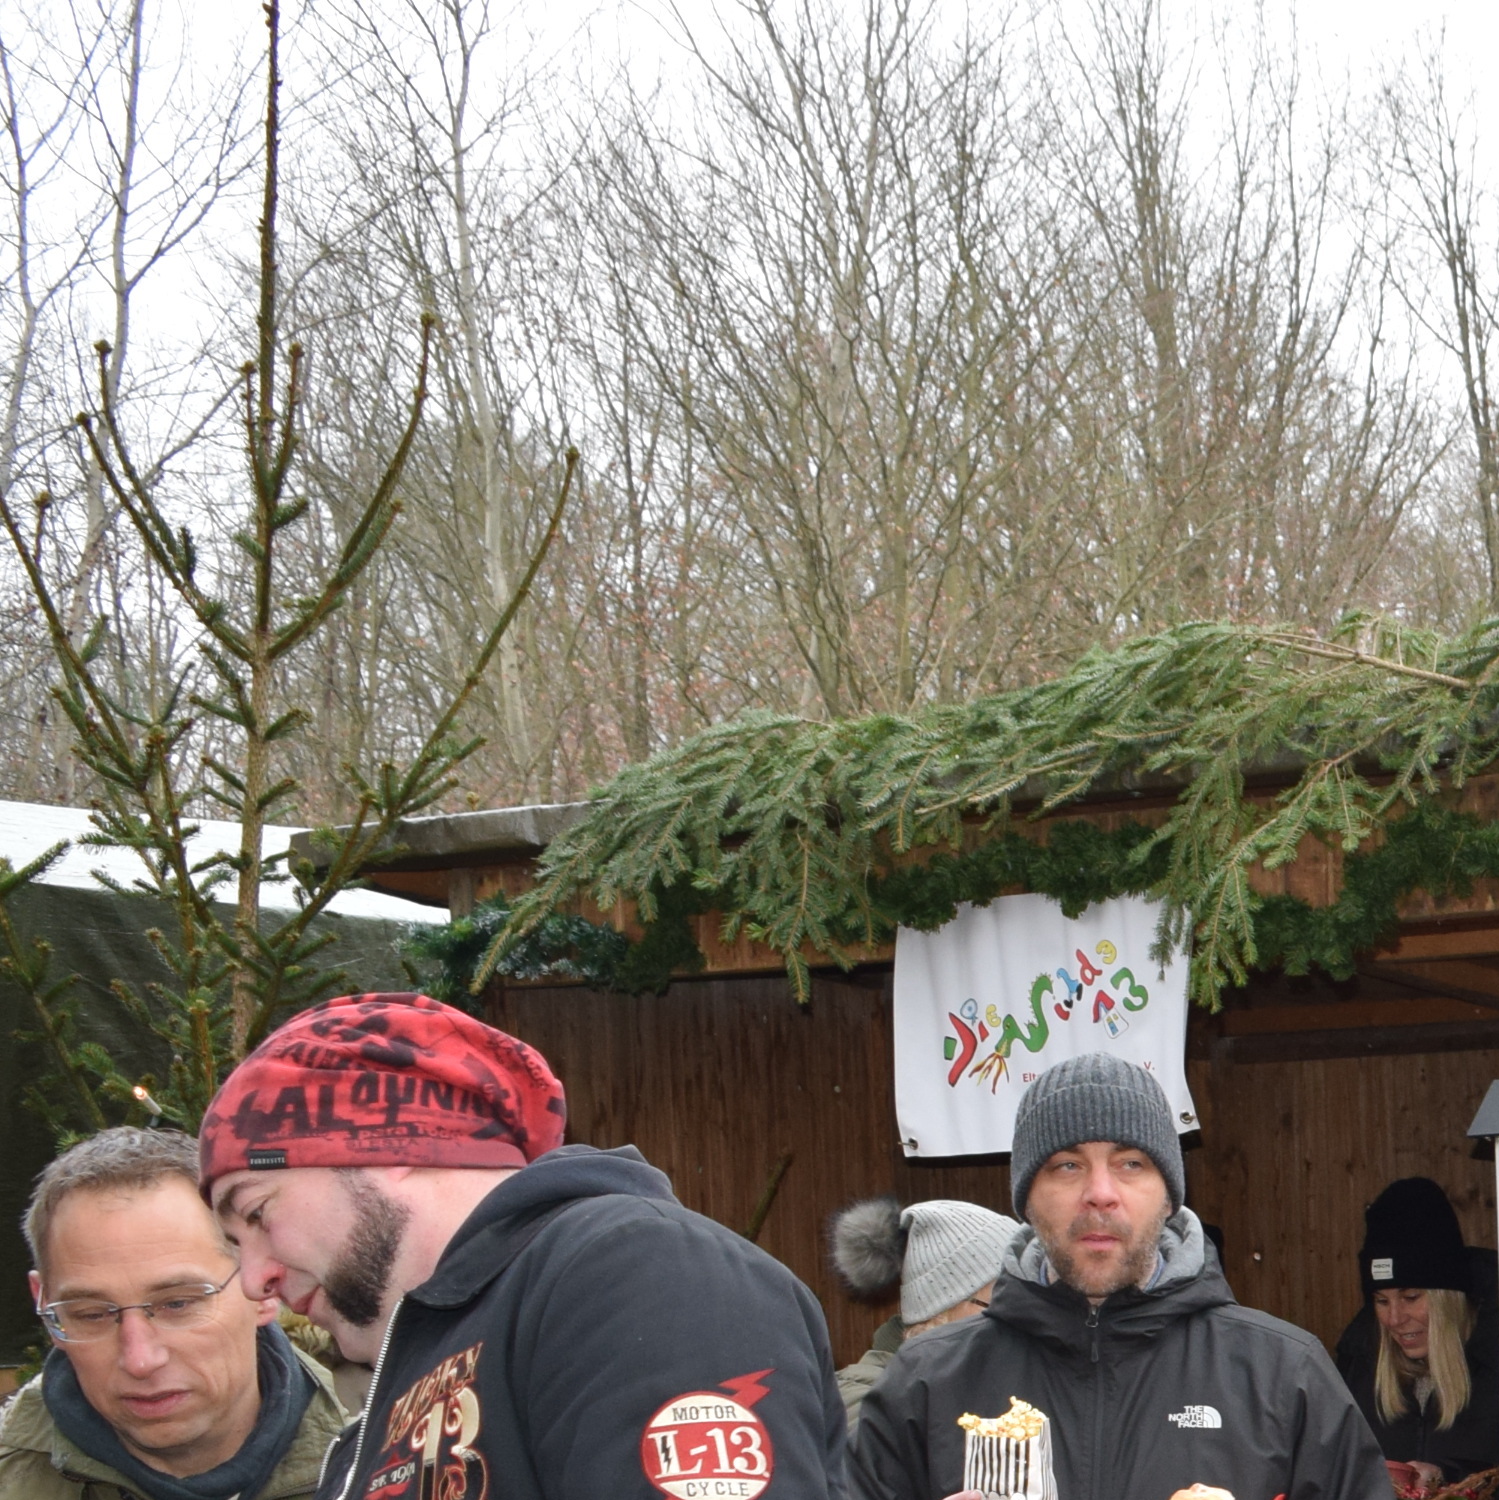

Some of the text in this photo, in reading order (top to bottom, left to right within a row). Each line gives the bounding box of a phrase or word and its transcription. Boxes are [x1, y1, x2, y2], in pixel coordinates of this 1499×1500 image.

[672, 1405, 737, 1420] MOTOR
[1184, 1405, 1203, 1413] THE
[1168, 1413, 1203, 1421] NORTH
[1178, 1420, 1203, 1428] FACE
[685, 1481, 750, 1498] CYCLE
